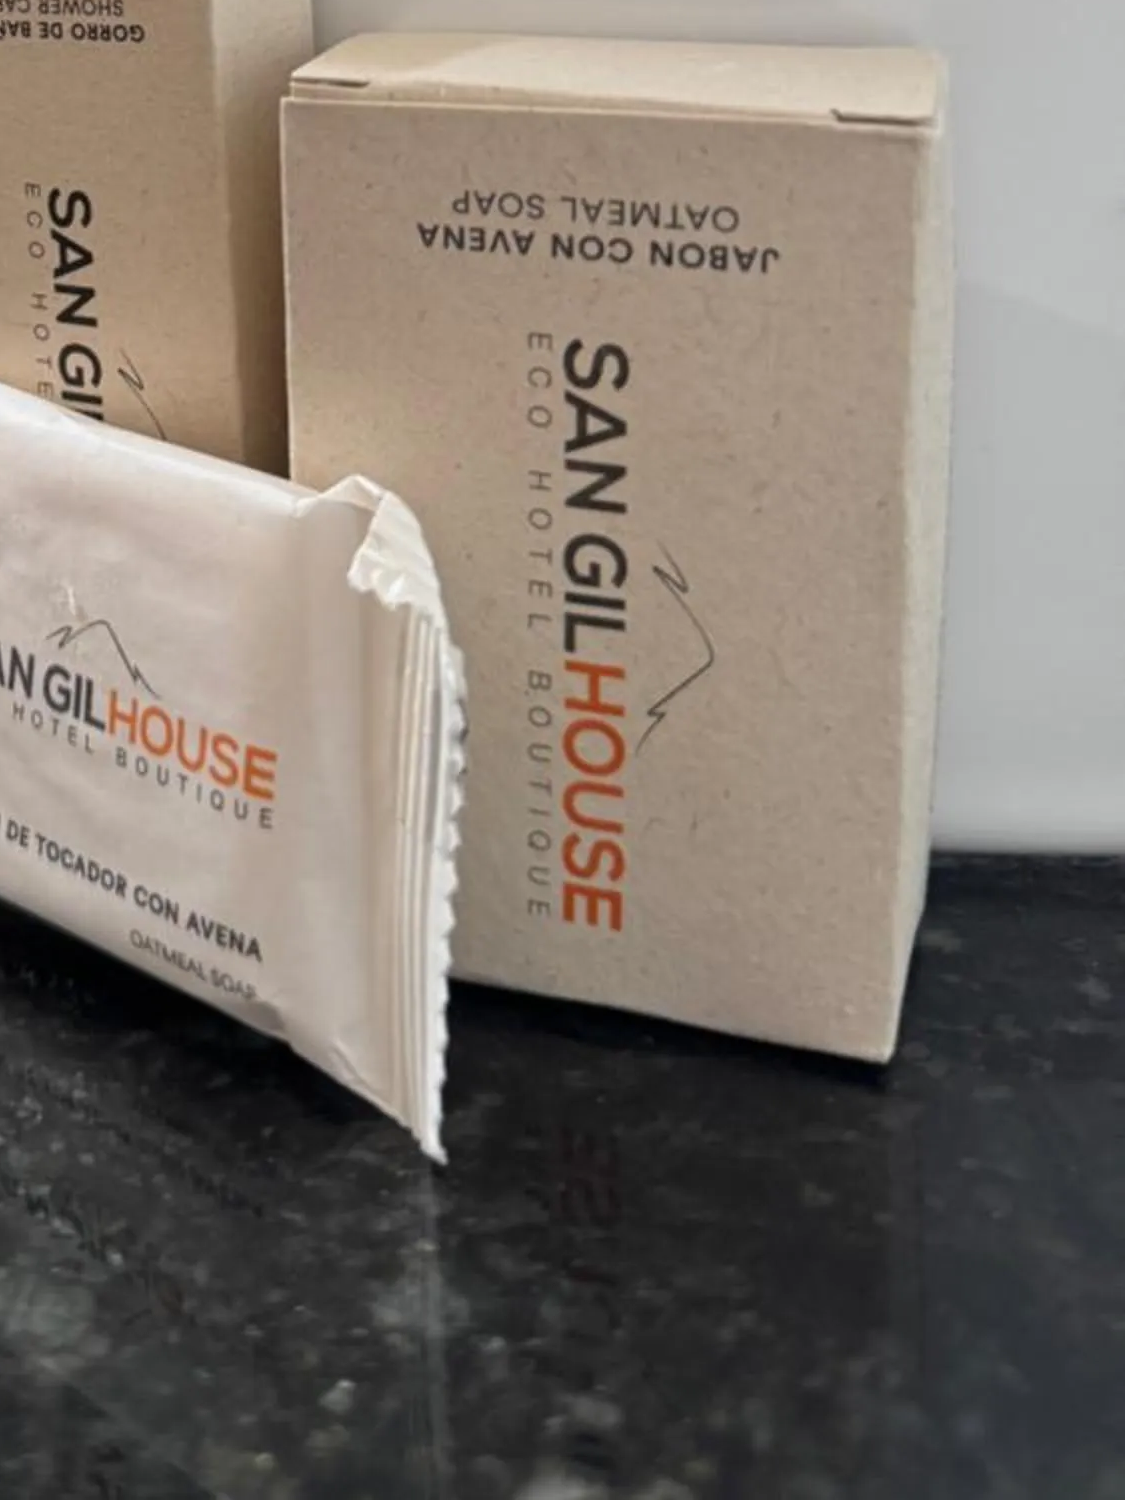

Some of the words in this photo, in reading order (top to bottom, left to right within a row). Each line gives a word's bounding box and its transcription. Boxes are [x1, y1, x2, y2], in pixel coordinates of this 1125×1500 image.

[38, 21, 63, 40] DE
[70, 23, 146, 43] GORRO
[25, 182, 46, 260] ECO
[416, 222, 536, 256] AVENA
[451, 189, 546, 220] SOAP
[561, 195, 741, 234] OATMEAL
[47, 187, 99, 328] SAN
[550, 232, 634, 264] CON
[649, 240, 780, 274] JABON
[30, 292, 55, 400] HOTE
[527, 331, 553, 430] ECO
[562, 338, 630, 515] SAN
[527, 469, 554, 630] HOTEL
[11, 702, 94, 755] HOTEL
[115, 746, 274, 830] BOUTIQUE
[526, 668, 553, 917] BOUTIQUE
[6, 819, 31, 848] DE
[35, 832, 127, 898] TOCADOR
[133, 884, 179, 925] CON
[186, 910, 263, 964] AVENA
[129, 928, 206, 982] OATMEAL
